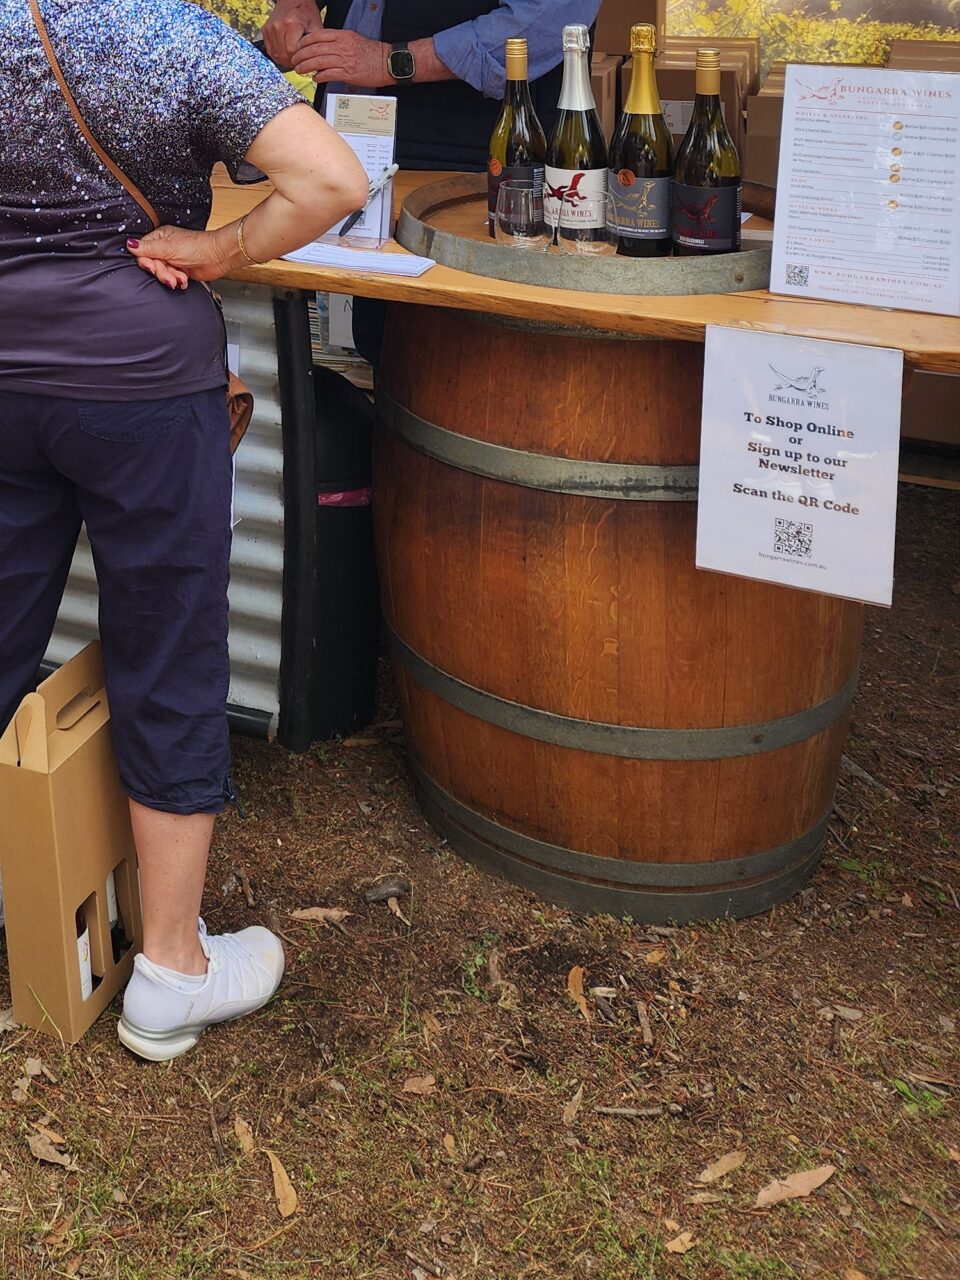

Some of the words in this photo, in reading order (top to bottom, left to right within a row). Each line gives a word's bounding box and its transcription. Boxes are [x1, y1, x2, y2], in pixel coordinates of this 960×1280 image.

[840, 85, 907, 96] BUNGARRA
[912, 89, 952, 99] WINES
[768, 394, 805, 407] BUNGARRA
[806, 399, 830, 410] WINES
[744, 412, 762, 424] To
[765, 416, 803, 432] Shop
[806, 422, 855, 439] Online
[788, 436, 803, 445] or
[747, 442, 780, 457] Sign
[784, 450, 802, 462] up
[806, 452, 820, 463] to
[823, 457, 848, 468] our
[758, 458, 835, 481] Newsletter
[732, 483, 768, 499] Scan
[771, 490, 795, 503] the
[798, 495, 820, 508] QR
[823, 500, 859, 515] Code
[758, 552, 827, 570] bungarrawines.com.au
